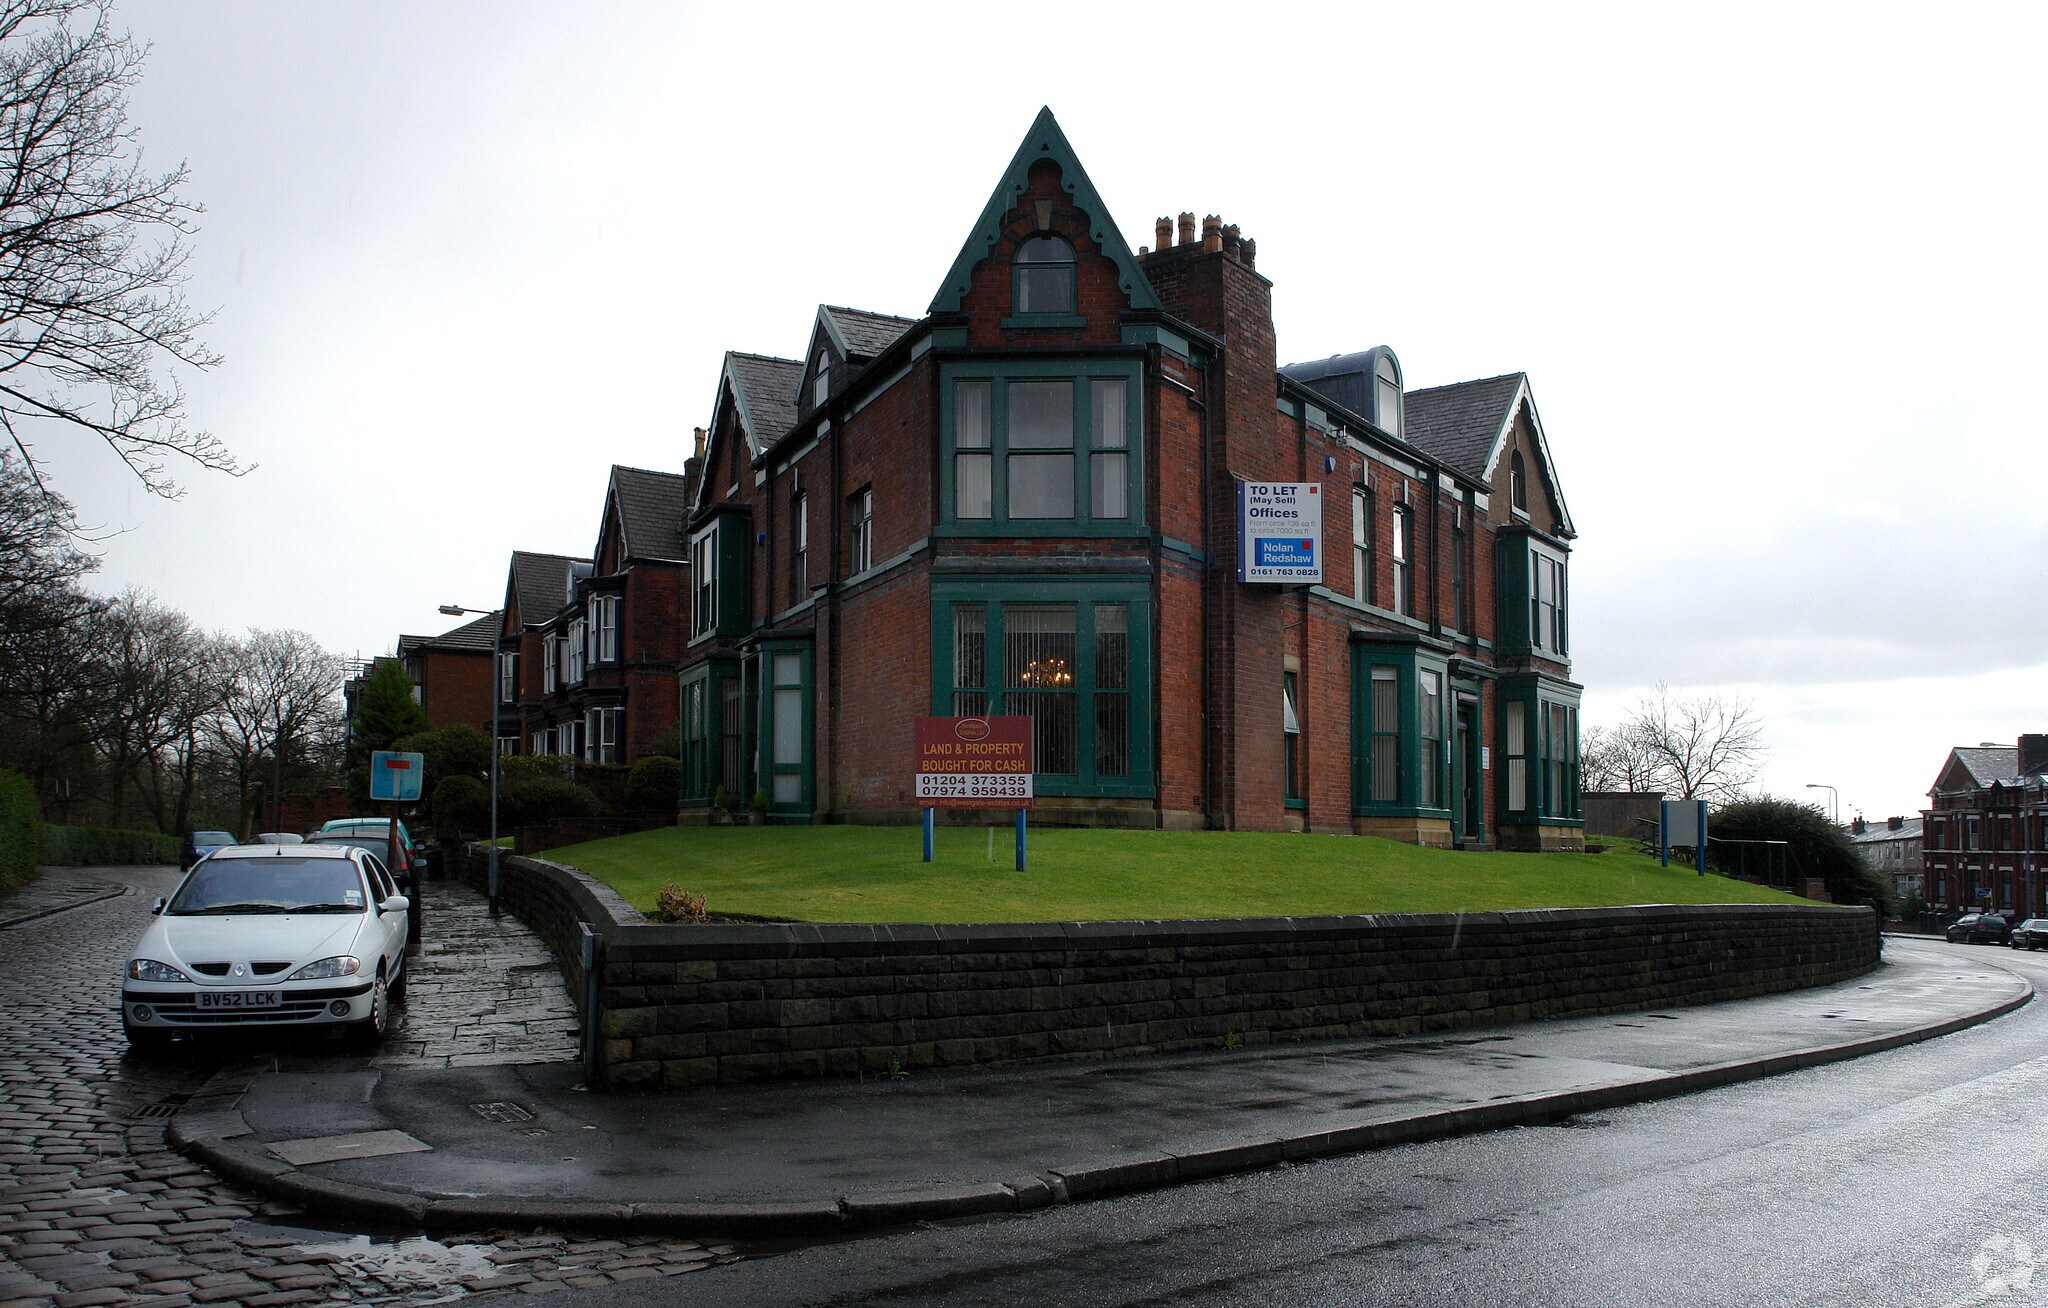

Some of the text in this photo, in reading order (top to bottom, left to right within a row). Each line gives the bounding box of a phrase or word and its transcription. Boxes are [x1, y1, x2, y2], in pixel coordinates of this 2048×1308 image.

[1250, 486, 1297, 496] TO LET
[1250, 497, 1296, 505] (May Sell)
[1250, 508, 1298, 518] Offices
[1264, 543, 1294, 552] Nolan
[1264, 553, 1312, 563] Redshaw
[923, 743, 1024, 755] LAND & PROPERTY
[922, 760, 1026, 771] BOUGHT FOR CASH
[922, 775, 1026, 785] 01204 373355
[922, 786, 1026, 796] 07974 959439
[202, 992, 275, 1006] BV52 LCK
